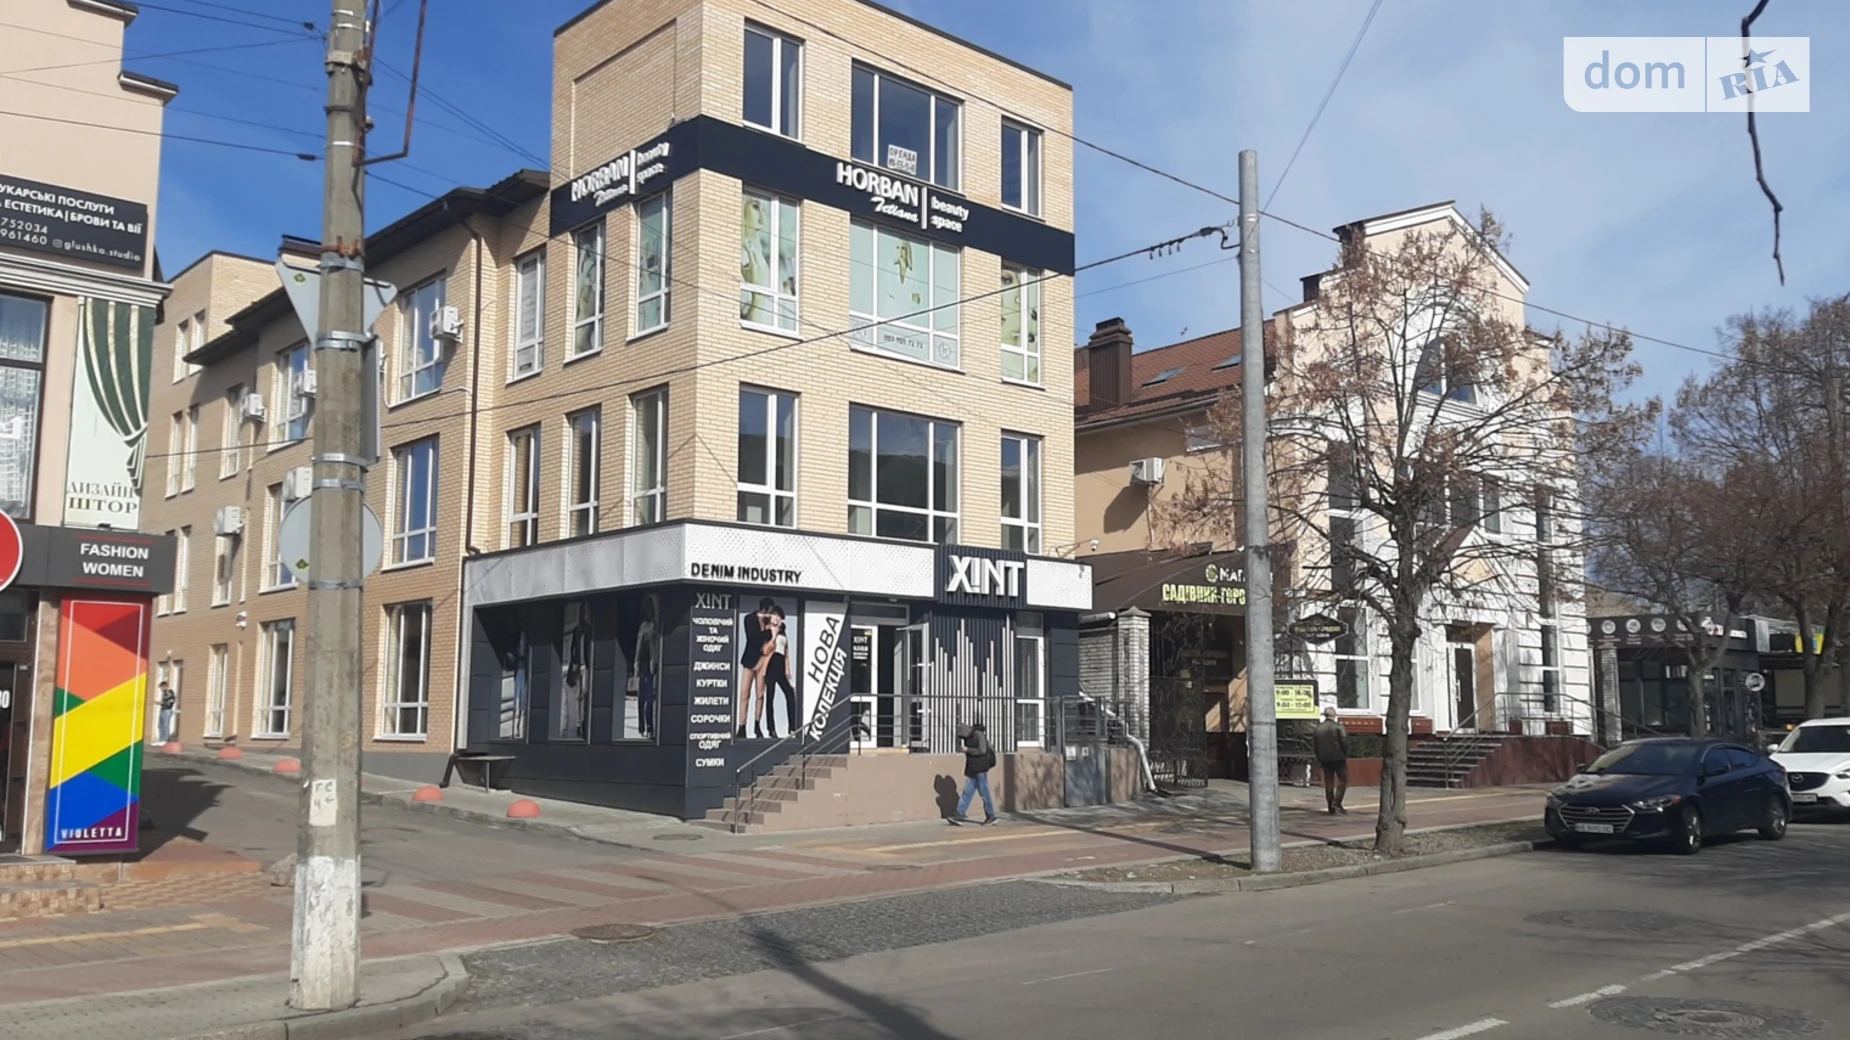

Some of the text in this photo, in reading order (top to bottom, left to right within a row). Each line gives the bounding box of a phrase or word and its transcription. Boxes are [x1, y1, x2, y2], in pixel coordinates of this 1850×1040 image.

[836, 161, 919, 207] HORBAN
[57, 197, 115, 215] ПОСЛУГИ
[931, 196, 969, 221] beauty
[111, 220, 126, 233] ТА
[127, 222, 143, 235] ВІЇ
[930, 215, 963, 233] space
[67, 481, 134, 499] ДИЗАЙН
[69, 497, 137, 514] ШТОР
[80, 543, 149, 560] FASHION
[83, 562, 144, 577] WOMEN
[691, 562, 802, 583] DENIM INDUSTRY
[1162, 583, 1247, 606] САДІВНИК-ГОРО
[708, 627, 718, 635] ТА
[696, 634, 729, 644] ЖІНОЧИЙ
[703, 644, 722, 654] ОДЯГ
[807, 616, 840, 683] НОВА
[693, 662, 731, 672] ДЖИНСИ
[696, 679, 727, 688] КУРТКИ
[694, 696, 729, 706] ЖИЛЕТИ
[808, 647, 848, 742] КОЛЕКЦІЯ
[691, 714, 731, 724] СОРОЧКИ
[698, 740, 722, 749] ОДЯГ
[695, 757, 725, 768] СУМКИ
[61, 827, 123, 840] VIOLETTA
